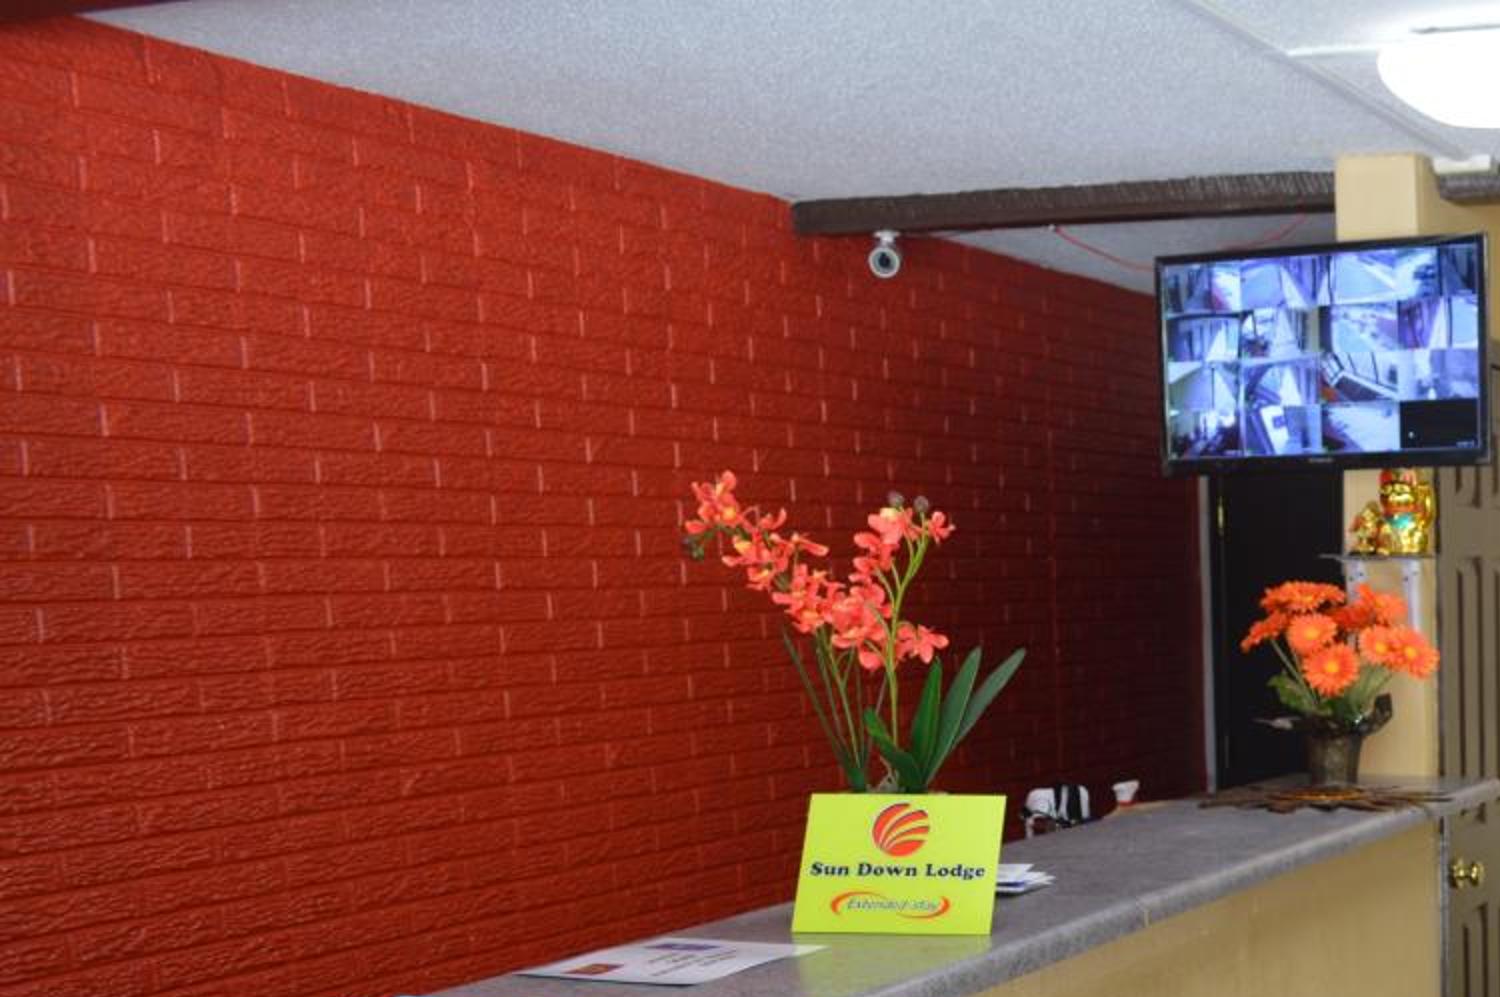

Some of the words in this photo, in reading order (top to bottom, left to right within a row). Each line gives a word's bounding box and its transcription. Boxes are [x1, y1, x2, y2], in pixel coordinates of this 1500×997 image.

[810, 861, 849, 876] Sun
[858, 863, 917, 876] Down
[926, 863, 985, 880] Lodge
